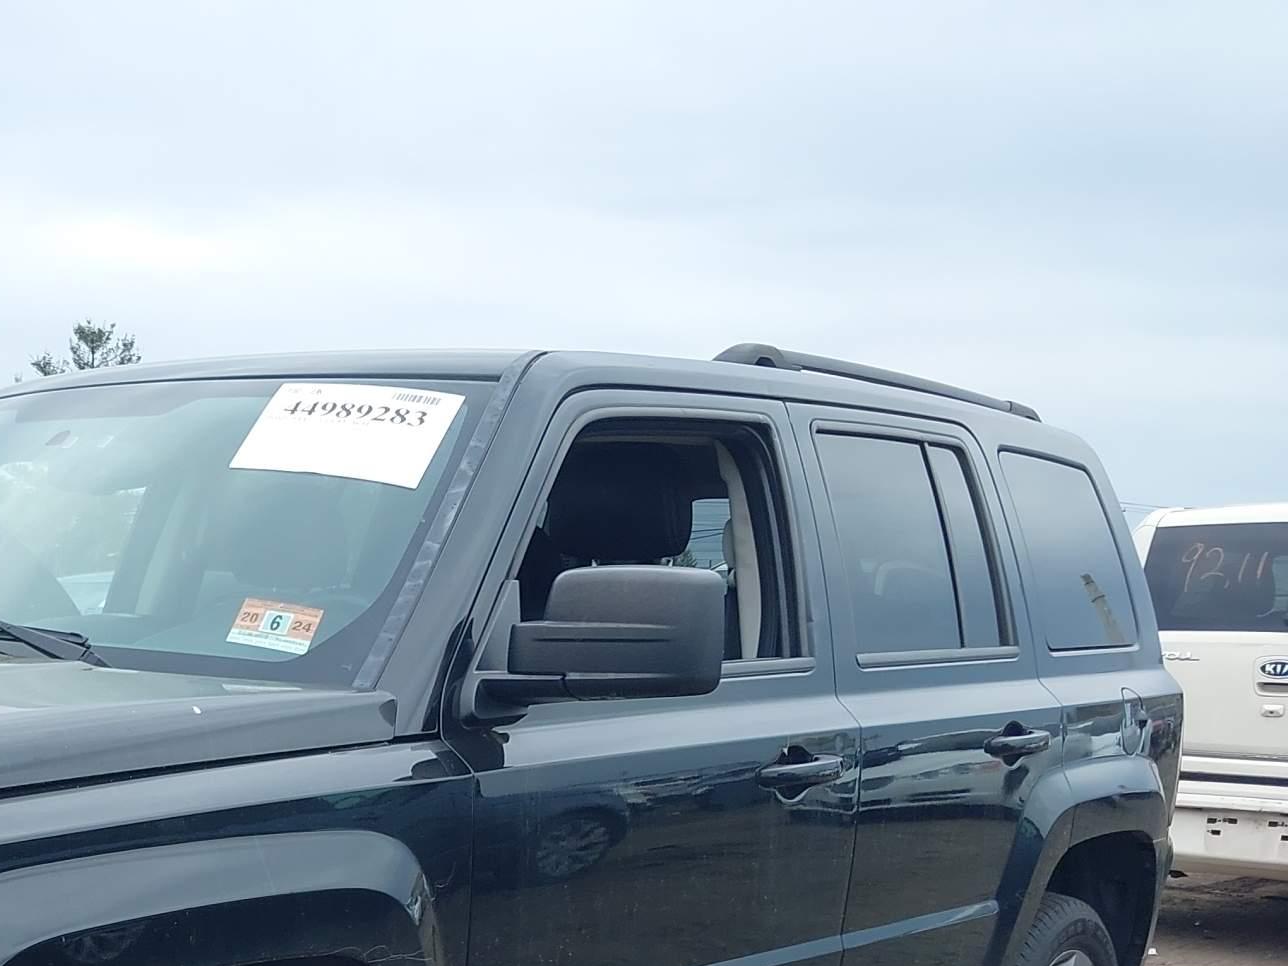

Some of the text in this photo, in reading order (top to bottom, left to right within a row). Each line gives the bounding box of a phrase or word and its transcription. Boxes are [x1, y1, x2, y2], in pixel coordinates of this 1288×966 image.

[284, 400, 428, 427] 44989283
[240, 611, 312, 633] 20 6 24
